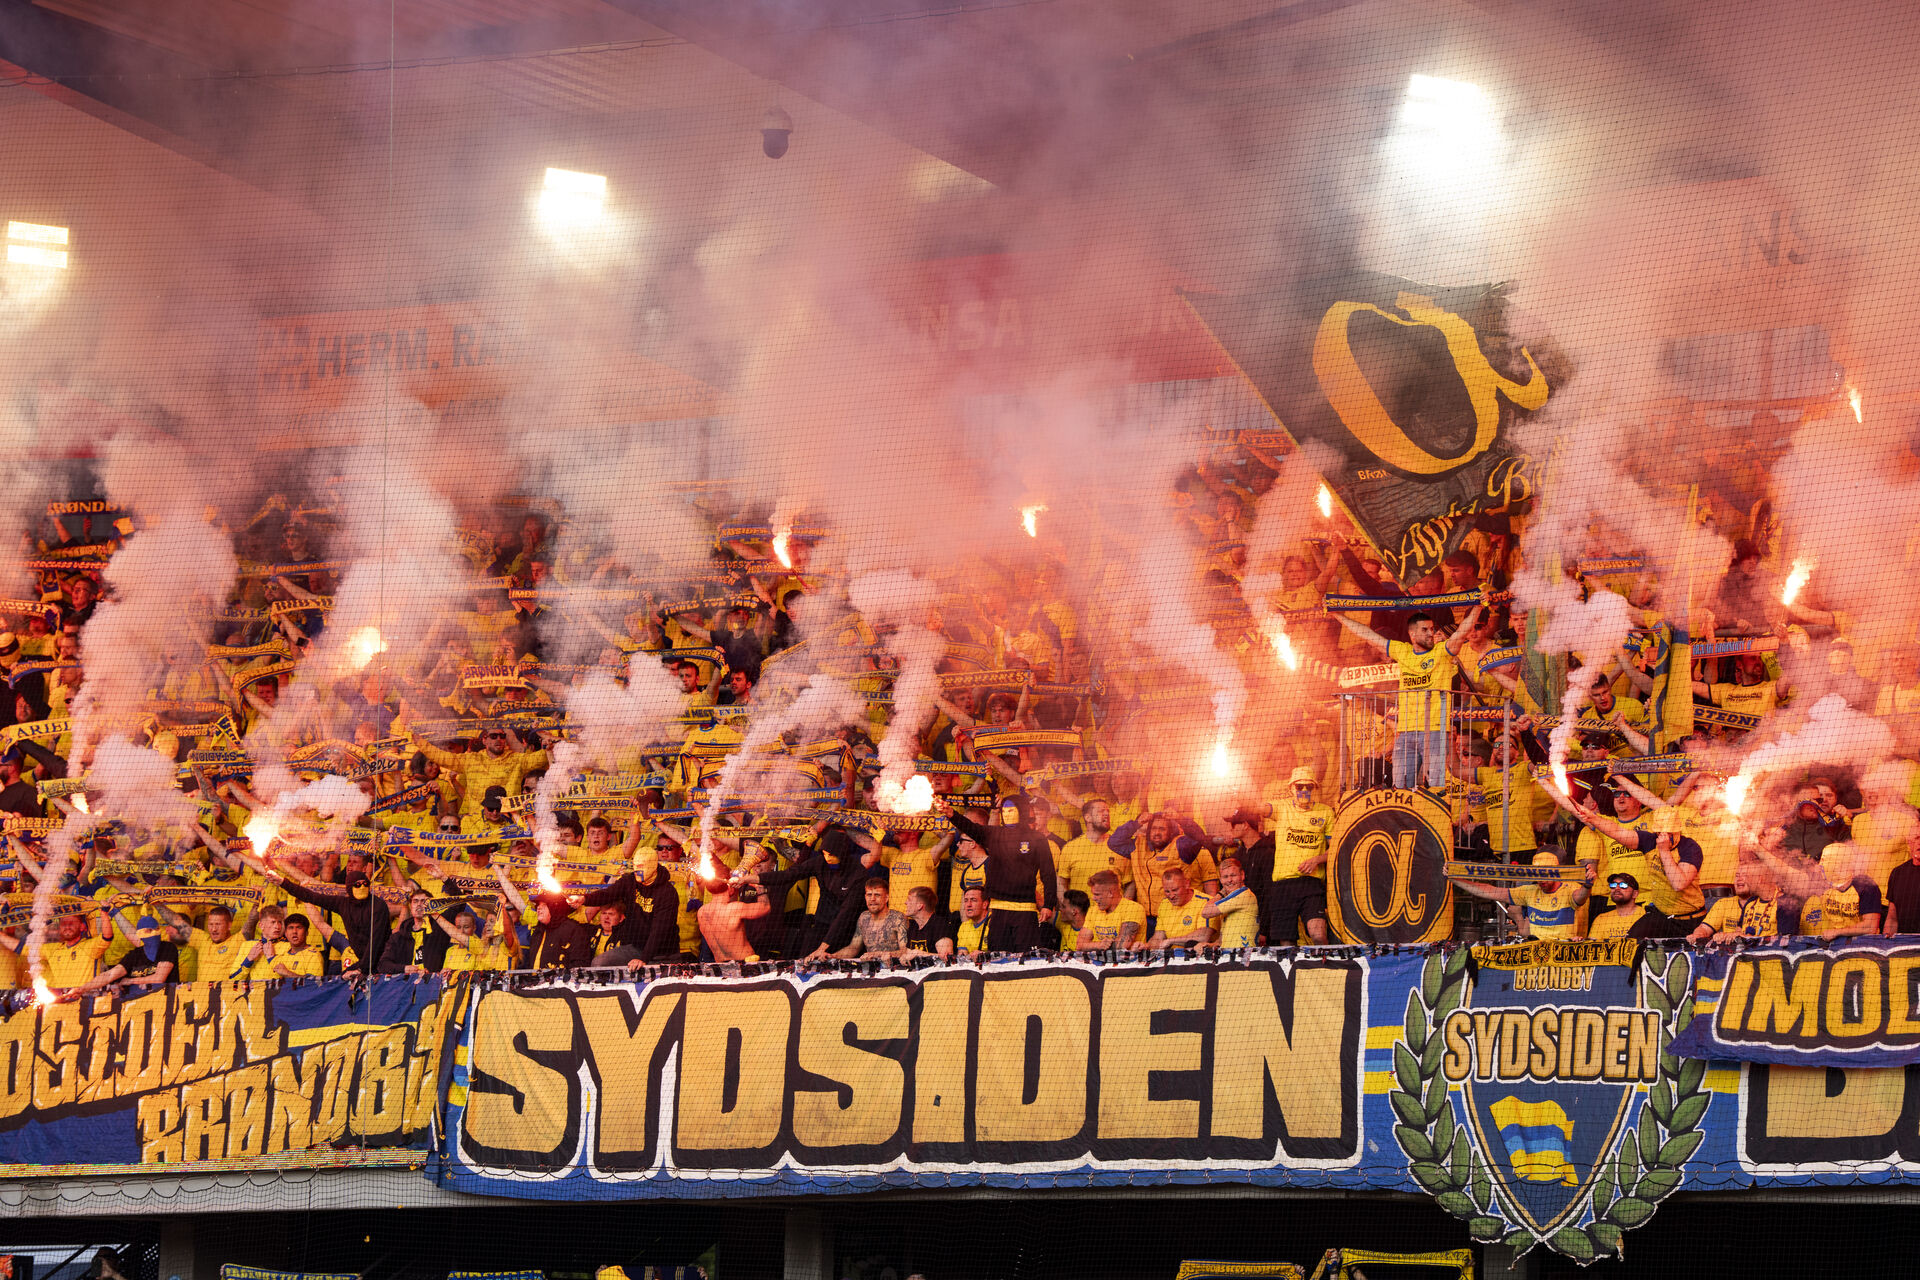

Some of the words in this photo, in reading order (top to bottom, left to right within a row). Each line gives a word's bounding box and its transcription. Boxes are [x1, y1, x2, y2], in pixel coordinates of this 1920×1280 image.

[1365, 791, 1413, 810] ALPHA
[1286, 832, 1319, 844] BRØNDBY
[1492, 946, 1533, 966] THE
[1552, 942, 1619, 965] UNITY
[1514, 966, 1594, 990] BRØNDBY
[462, 960, 1349, 1153] SYDSIDEN
[1444, 1010, 1660, 1081] SYDSIDEN
